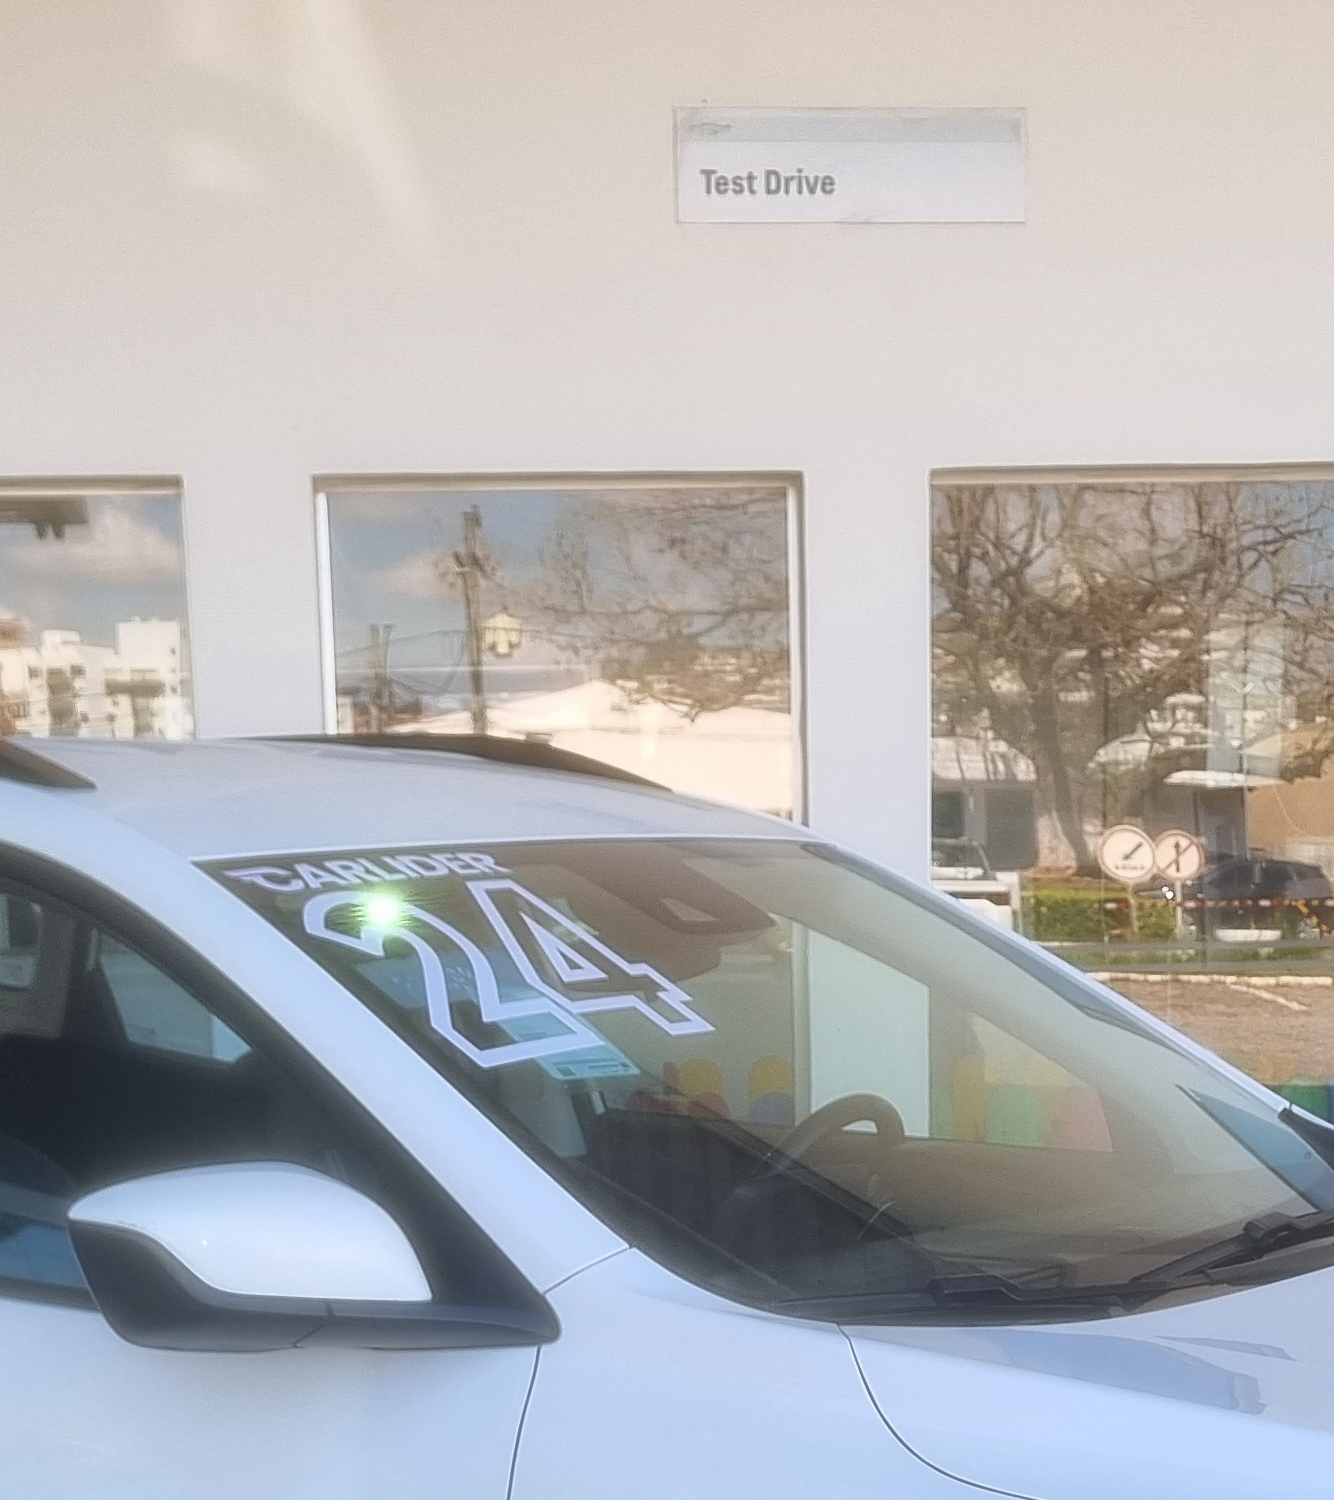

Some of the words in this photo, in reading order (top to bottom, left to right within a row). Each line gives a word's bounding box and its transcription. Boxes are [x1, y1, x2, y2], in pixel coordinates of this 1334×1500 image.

[699, 168, 758, 196] Test
[763, 167, 836, 196] Drive
[222, 851, 511, 891] CARLIDER
[302, 878, 715, 1067] 24
